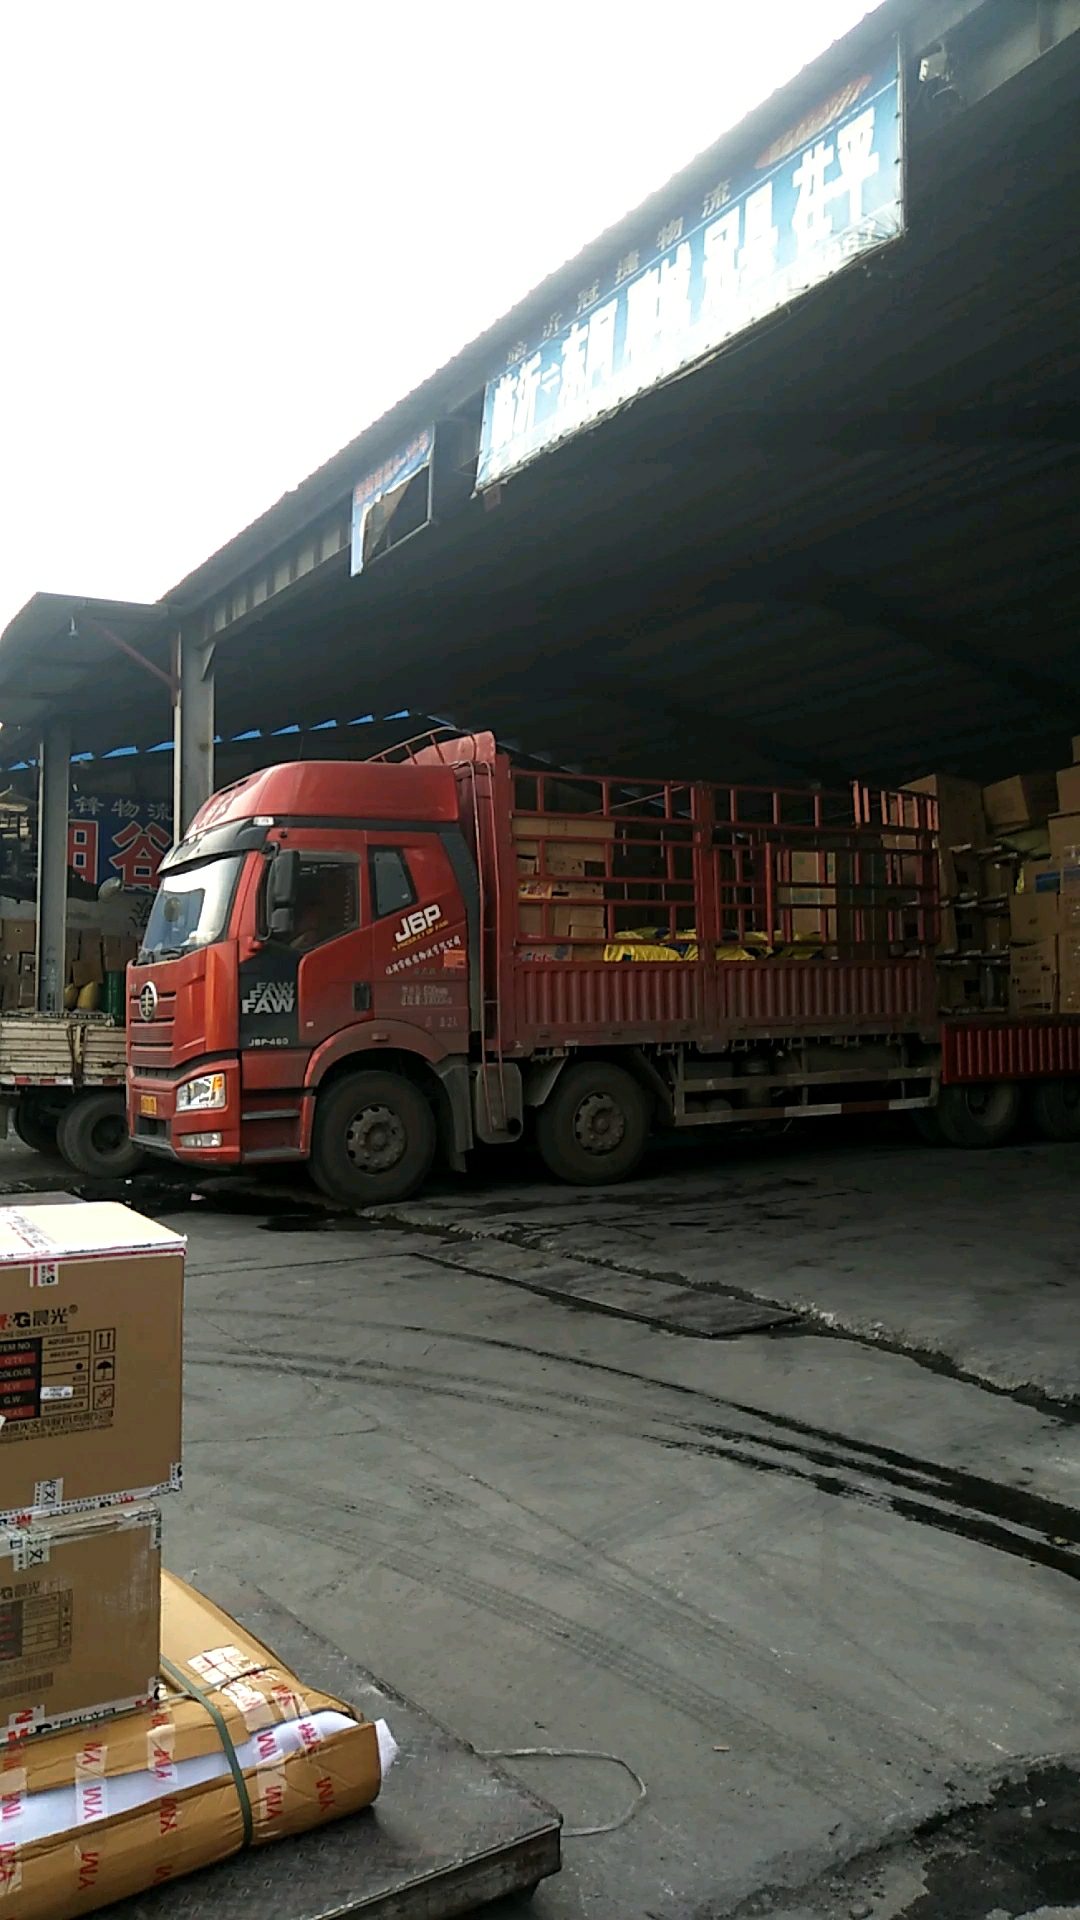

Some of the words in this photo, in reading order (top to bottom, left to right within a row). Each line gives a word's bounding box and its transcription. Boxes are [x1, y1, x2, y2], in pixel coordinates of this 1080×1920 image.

[394, 904, 442, 943] J6P
[249, 989, 294, 1000] FAW
[256, 981, 294, 991] FAW
[241, 997, 295, 1014] FAW
[83, 1786, 102, 1819] YM
[316, 1777, 335, 1812] YM
[78, 1852, 99, 1890] YM
